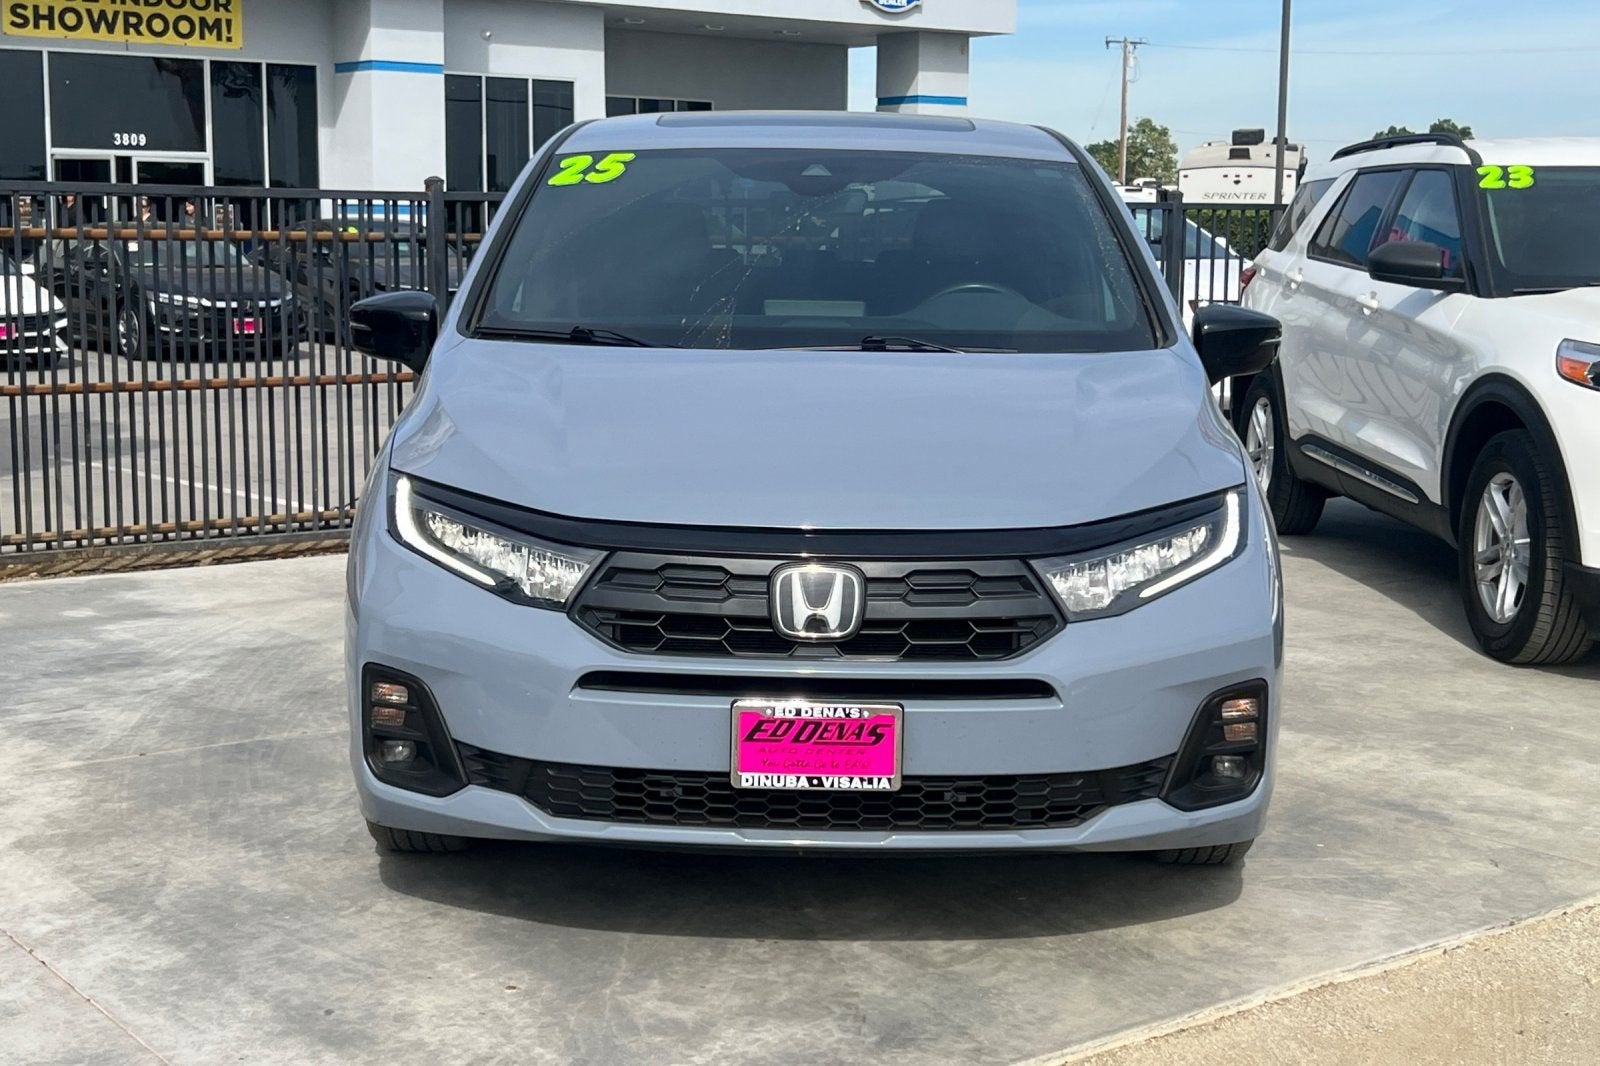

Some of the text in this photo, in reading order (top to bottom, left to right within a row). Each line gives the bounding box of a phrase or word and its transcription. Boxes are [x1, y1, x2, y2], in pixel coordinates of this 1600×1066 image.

[110, 0, 232, 13] OOR
[9, 3, 233, 42] SHOWROOM!
[114, 133, 147, 146] 3809
[547, 152, 636, 186] 25
[1476, 165, 1535, 189] 23
[1201, 192, 1267, 200] SPRINTER
[774, 706, 860, 718] ED DENA'S
[743, 720, 793, 742] ED
[741, 775, 891, 789] DINUBA VISALIA
